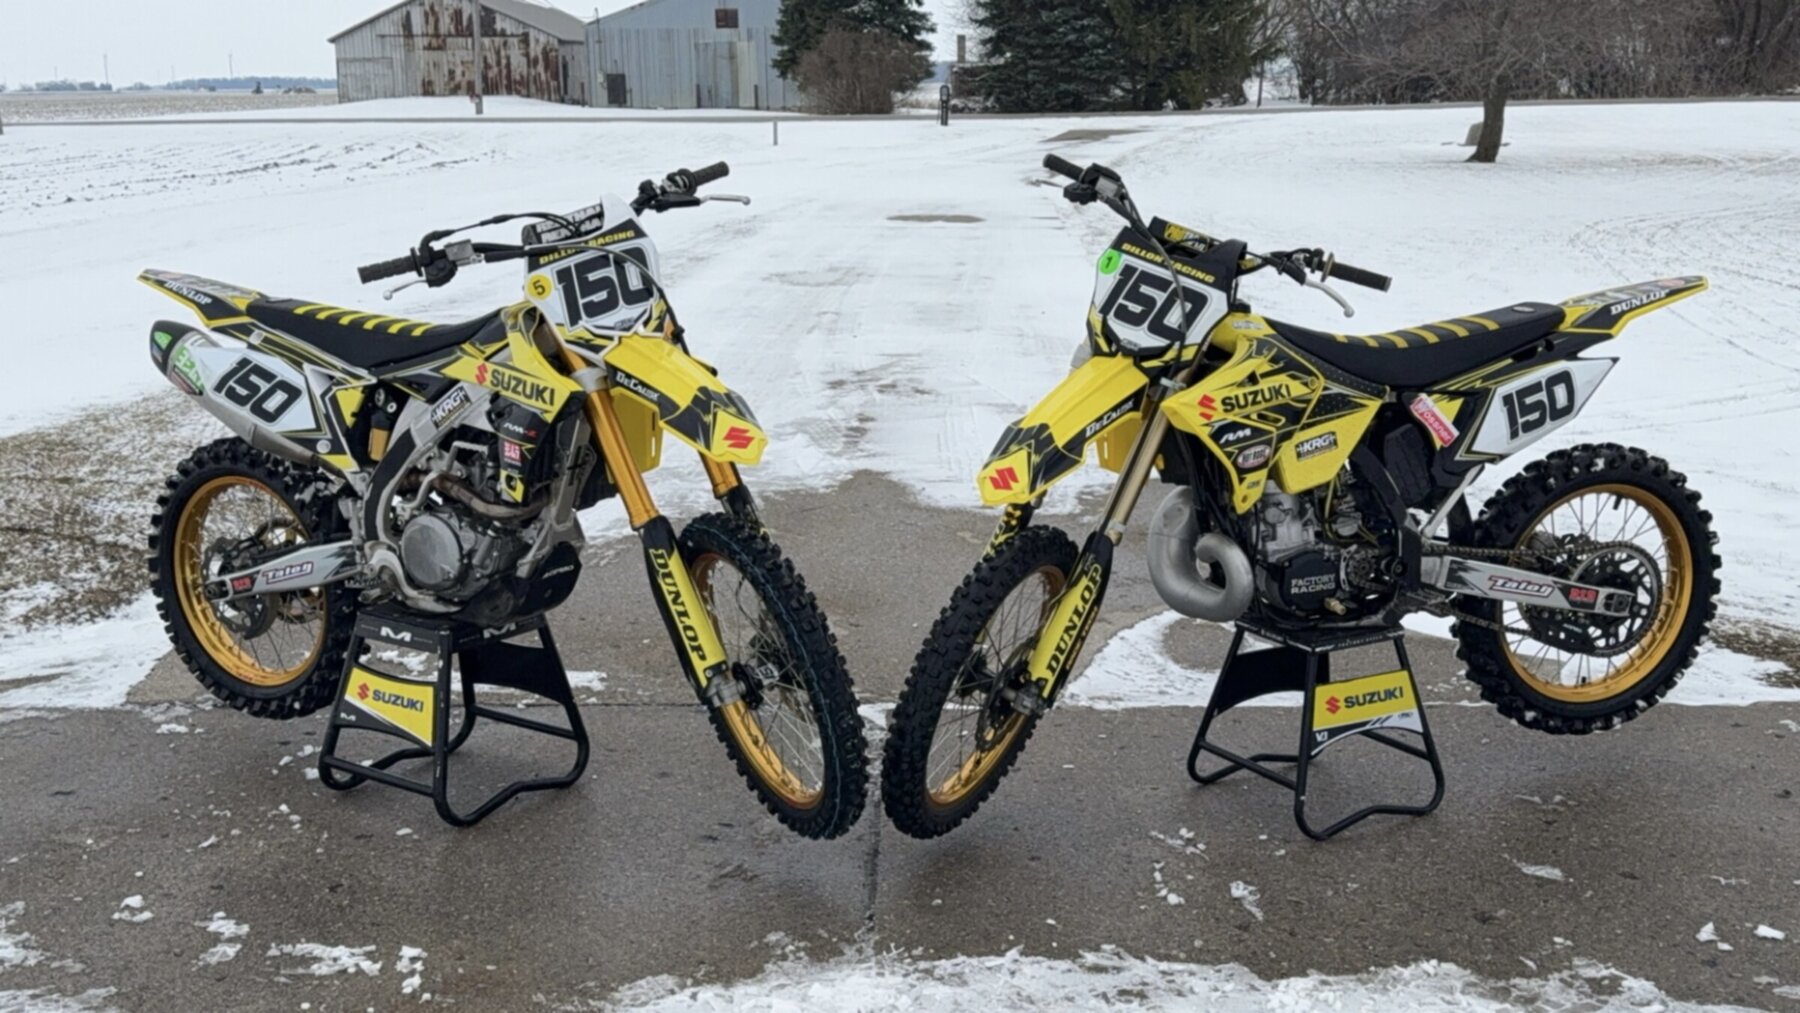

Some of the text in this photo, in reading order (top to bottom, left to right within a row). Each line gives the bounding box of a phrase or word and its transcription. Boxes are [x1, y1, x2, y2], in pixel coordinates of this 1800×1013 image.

[539, 230, 635, 264] DILLO RACING
[1121, 243, 1164, 263] DILLON
[1105, 256, 1113, 269] 1
[164, 280, 213, 305] DUNLOP
[532, 280, 546, 296] 5
[555, 246, 654, 330] 150
[1098, 264, 1209, 342] 150
[1610, 289, 1669, 315] DUNLOP
[213, 357, 303, 423] 150
[490, 369, 555, 406] SUZUKI
[1221, 384, 1292, 413] SUZUKI
[1502, 370, 1575, 441] 150
[1291, 573, 1336, 587] FACTORY
[1291, 583, 1335, 594] RACING
[650, 549, 707, 661] DUNLOP
[1046, 564, 1102, 677] DUNLOP
[372, 689, 424, 712] SUZUKI
[1344, 686, 1403, 708] SUZUKI
